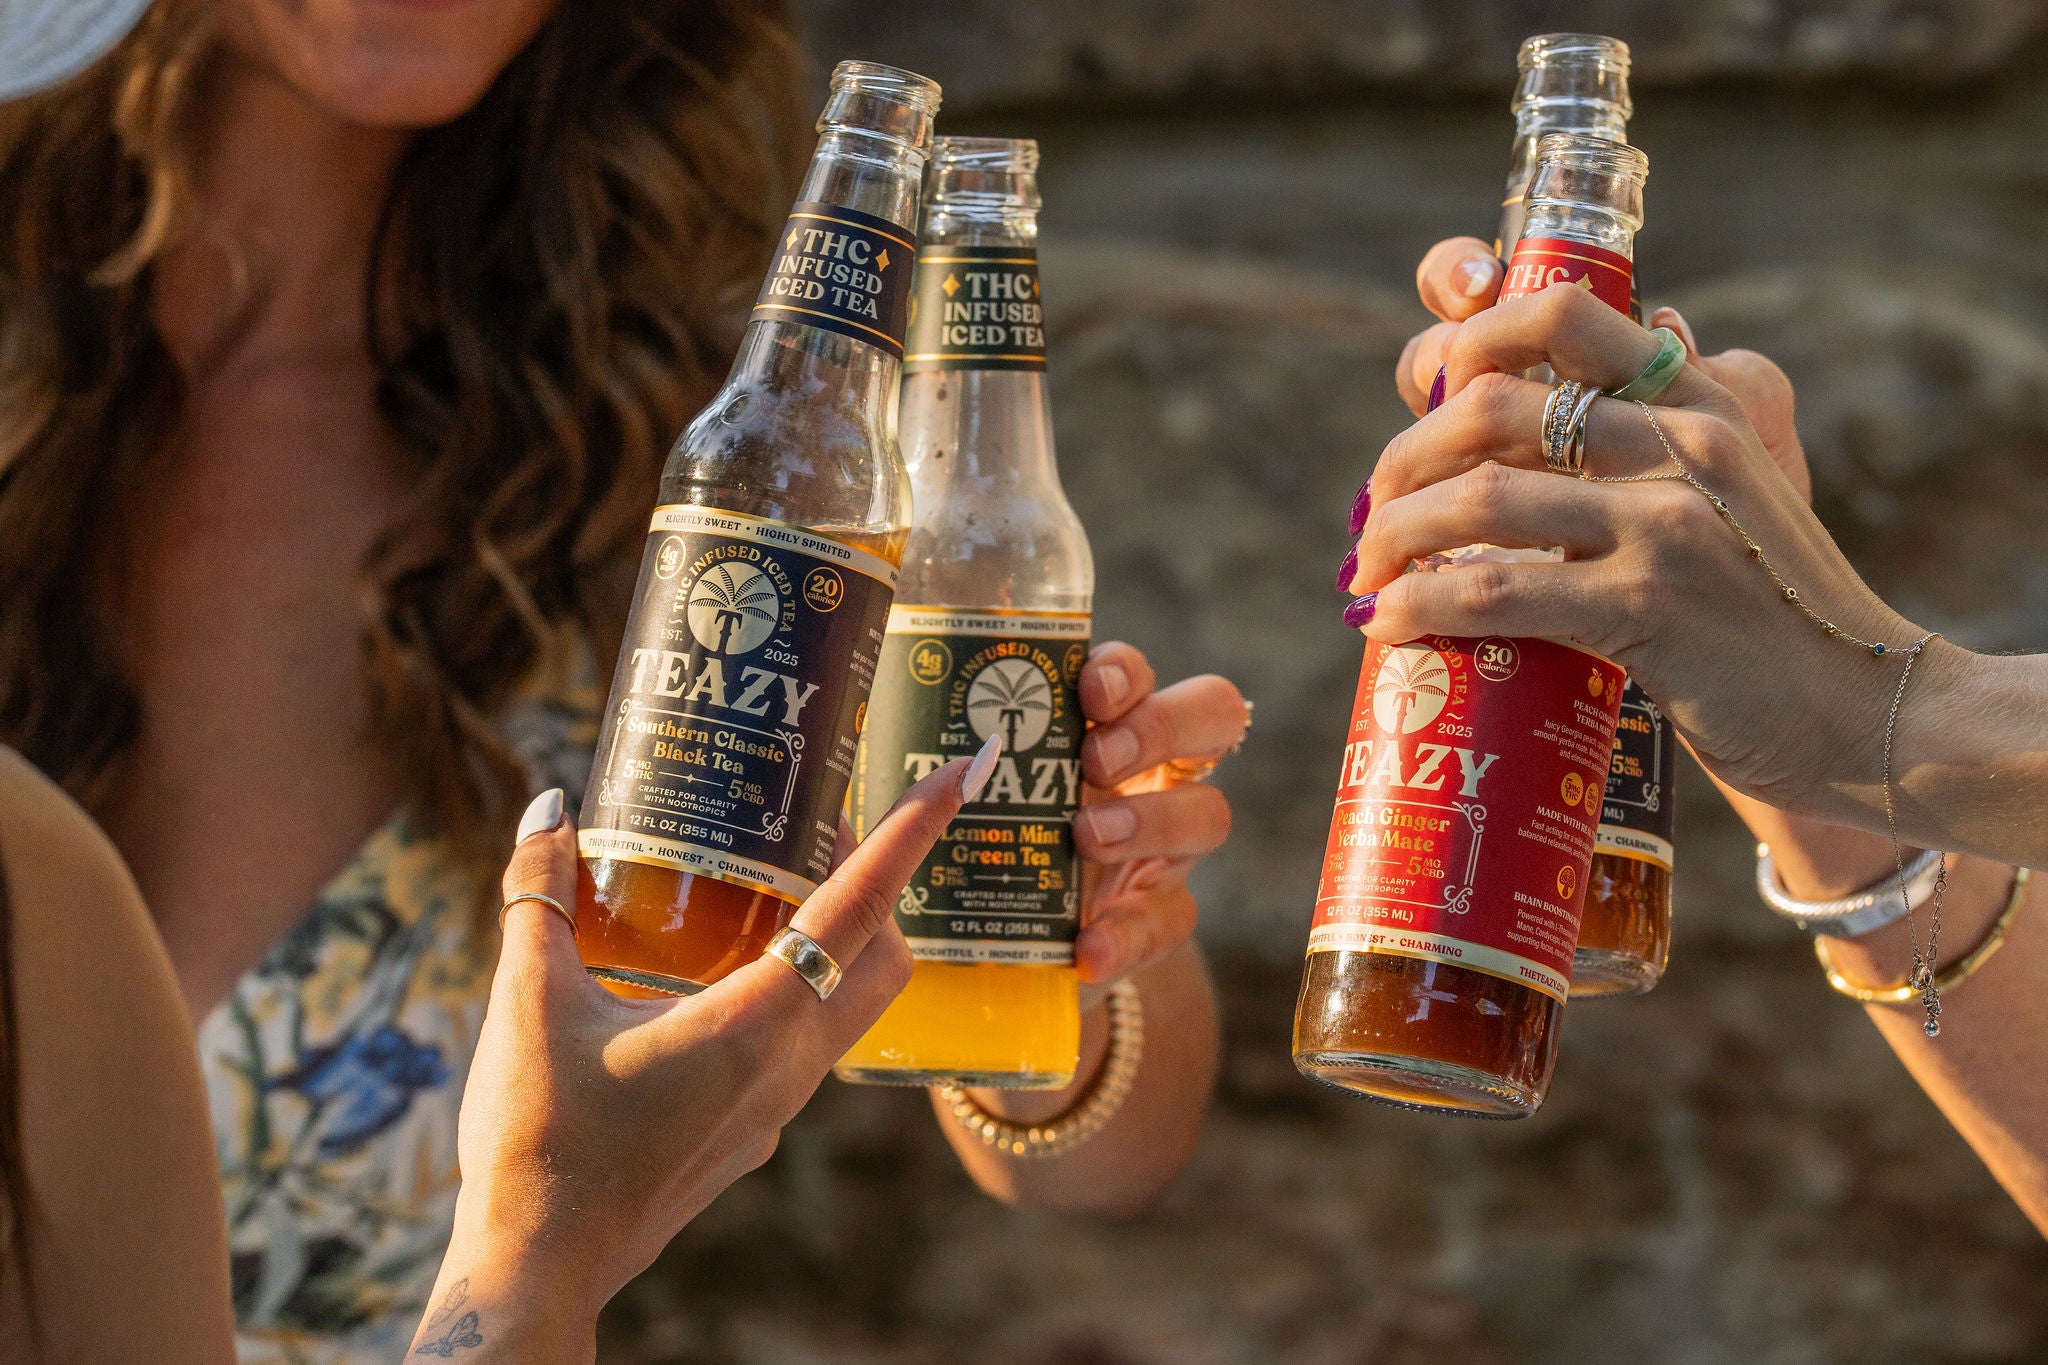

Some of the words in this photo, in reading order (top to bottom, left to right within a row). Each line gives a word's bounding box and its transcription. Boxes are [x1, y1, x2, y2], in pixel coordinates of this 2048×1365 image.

[803, 228, 871, 265] THC
[777, 255, 883, 295] INFUSED
[1509, 264, 1570, 289] THC
[965, 273, 1031, 298] THC
[768, 276, 825, 300] ICED
[831, 287, 879, 320] TEA
[943, 302, 1043, 323] INFUSED
[942, 325, 1006, 346] ICED
[1010, 327, 1045, 348] TEA
[665, 514, 703, 525] SLIGHTLY
[704, 518, 741, 531] SWEET
[756, 527, 800, 544] HIGHLY
[802, 537, 851, 560] SPIRITED
[661, 546, 679, 564] 4g
[673, 577, 692, 613] THC
[689, 545, 761, 577] INFUSED
[761, 556, 793, 596] ICED
[779, 600, 796, 632] TEA
[811, 575, 838, 597] 20
[807, 591, 836, 606] calories
[910, 616, 964, 629] SLIGHTLY
[967, 618, 1005, 630] SWEET
[660, 629, 683, 641] EST.
[764, 648, 799, 667] 2025
[963, 642, 1030, 680] INFUSED
[1032, 648, 1060, 684] ICED
[1482, 645, 1513, 665] 30
[1433, 636, 1463, 669] ICED
[1452, 671, 1467, 705] TEA
[1479, 662, 1512, 675] calories
[629, 648, 820, 727] TEAZY
[1574, 700, 1599, 716] PEACH
[1355, 719, 1368, 732] EST.
[1437, 723, 1473, 738] 2025
[1544, 719, 1560, 732] Juicy
[1561, 724, 1582, 740] Georgia
[1576, 713, 1599, 731] YERBA
[1617, 714, 1650, 734] ssic
[627, 715, 709, 744] Southern
[714, 730, 785, 763] Classic
[940, 733, 970, 746] EST.
[1533, 729, 1558, 742] smooth
[1558, 736, 1575, 749] yerba
[653, 741, 707, 766] Black
[711, 752, 744, 775] Tea
[1559, 749, 1571, 760] and
[634, 769, 654, 780] THC
[904, 752, 1080, 805] TAZY
[638, 784, 676, 797] CRAFTED
[678, 791, 697, 801] FOR
[699, 796, 738, 811] CLARITY
[742, 792, 765, 806] CBD
[1564, 790, 1578, 801] THC
[644, 794, 666, 805] WITH
[667, 798, 726, 818] NOOTROPICS
[1604, 807, 1625, 823] ML)
[1336, 806, 1374, 827] Peach
[1379, 807, 1450, 832] Ginger
[1536, 805, 1561, 821] MADE
[1563, 815, 1581, 831] WITH
[629, 814, 641, 826] 12
[643, 816, 657, 828] FL
[659, 819, 676, 832] OZ
[679, 823, 708, 839] (355
[710, 830, 733, 847] ML)
[941, 827, 1014, 843] Lemon
[1019, 824, 1060, 845] Mint
[1518, 827, 1547, 844] balanced
[1531, 819, 1545, 831] Fast
[1545, 825, 1563, 839] acting
[1337, 828, 1377, 848] Yerba
[1381, 830, 1434, 852] Mate
[1615, 835, 1658, 854] CHARMING
[588, 838, 644, 853] THOUGHTFUL
[657, 847, 704, 865] HONEST
[718, 860, 774, 885] CHARMING
[952, 844, 1017, 865] Green
[1020, 846, 1051, 866] Tea
[1380, 876, 1416, 887] CLARITY
[1422, 867, 1445, 879] CBD
[1514, 891, 1542, 909] BRAIN
[1327, 906, 1335, 916] 12
[1335, 906, 1345, 916] FL
[1347, 906, 1361, 916] OZ
[1363, 907, 1389, 919] (355
[1391, 908, 1413, 923] ML)
[1517, 908, 1543, 925] Powered
[1543, 919, 1555, 930] with
[950, 921, 965, 933] 12
[967, 921, 982, 933] FL
[984, 922, 1003, 934] OZ
[1516, 920, 1534, 935] Mane,
[1400, 938, 1463, 957] CHARMING
[1507, 930, 1540, 950] supporting
